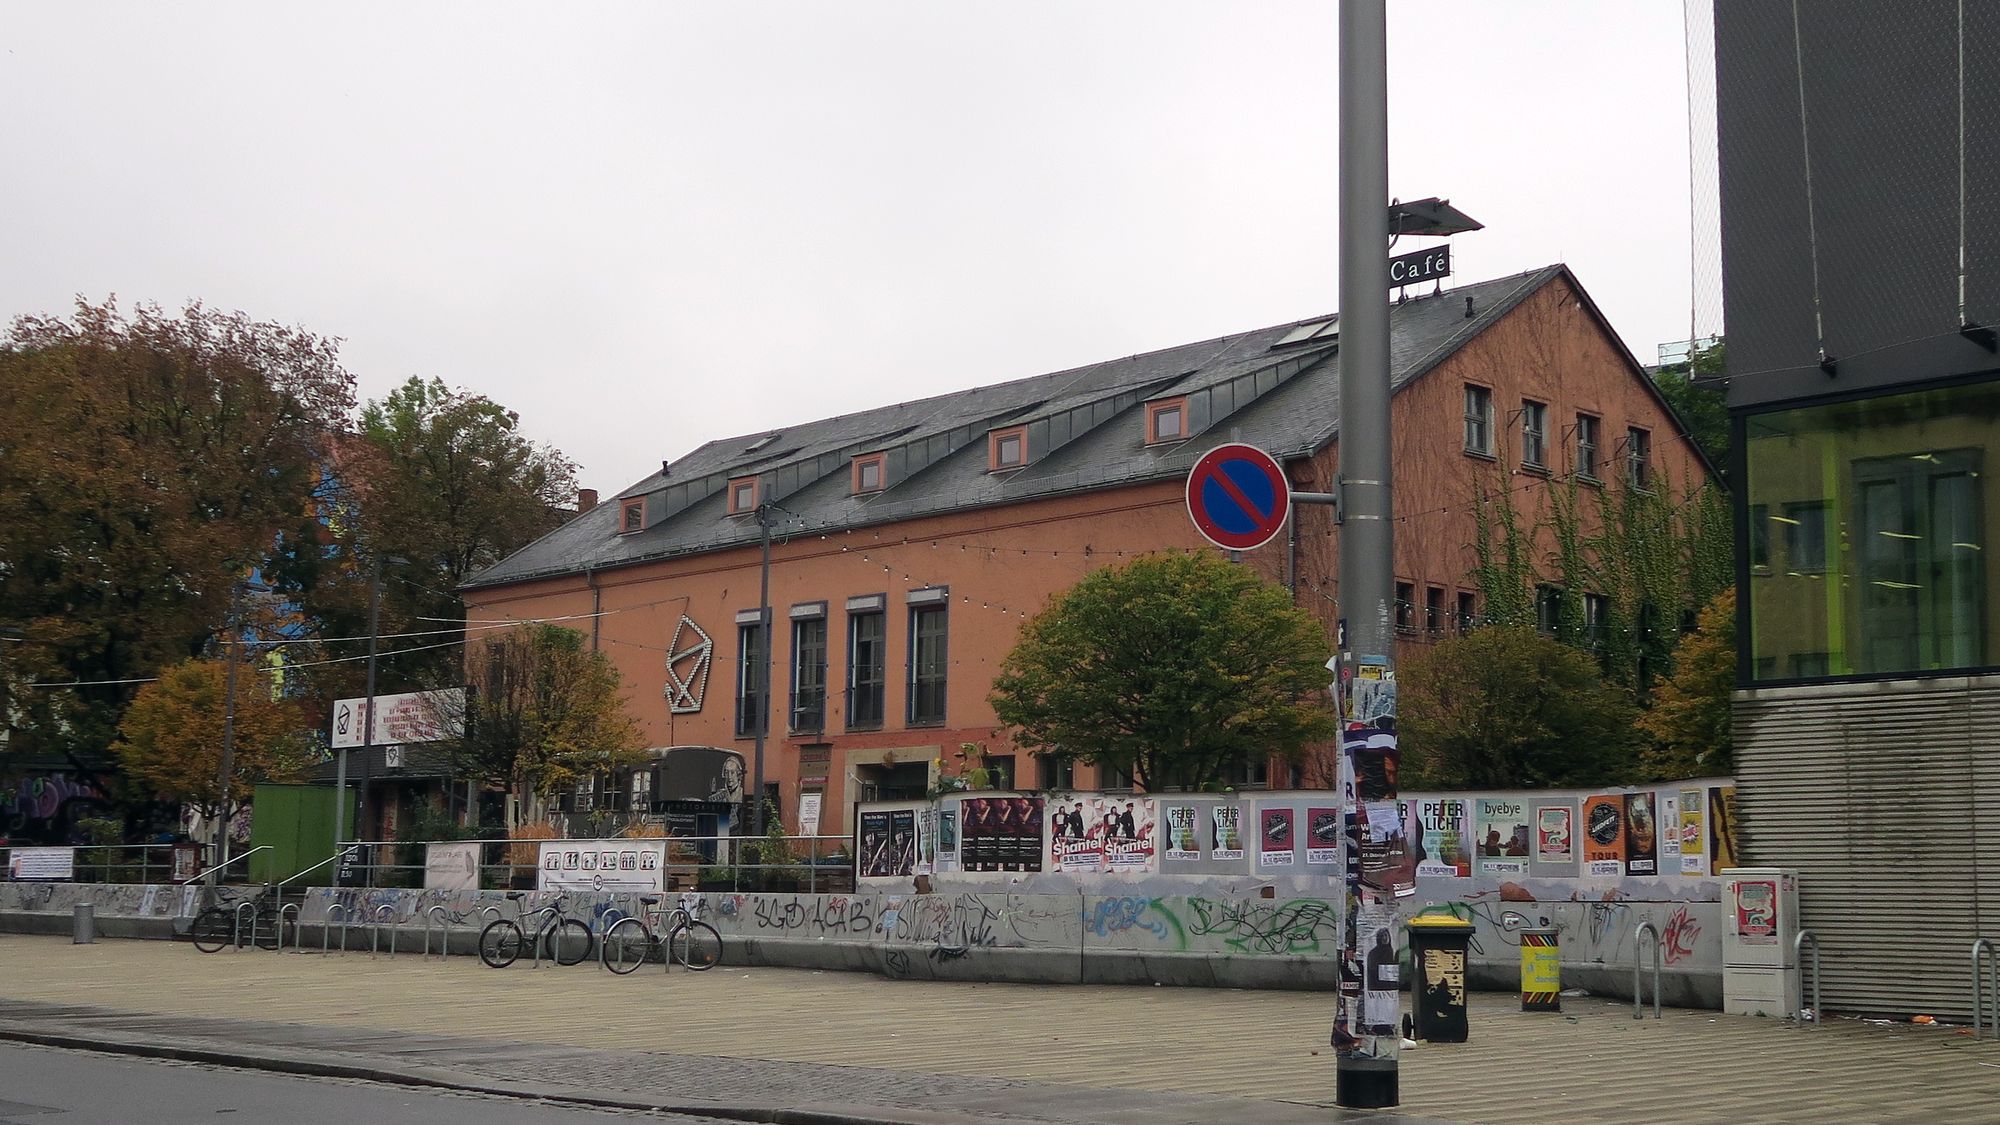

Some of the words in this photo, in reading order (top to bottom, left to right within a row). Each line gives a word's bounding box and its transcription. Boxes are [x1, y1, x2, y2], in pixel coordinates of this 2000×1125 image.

[1391, 253, 1446, 281] Café
[1171, 809, 1196, 819] PETER
[1217, 809, 1239, 818] PETER
[1424, 803, 1463, 816] PETER
[1485, 802, 1521, 817] byebye
[1172, 819, 1195, 828] LICHT
[1218, 819, 1239, 828] LICHT
[1425, 818, 1462, 831] LICHT
[1053, 837, 1102, 855] Shantel
[1104, 837, 1153, 855] Shantel
[1591, 852, 1618, 860] TOUR
